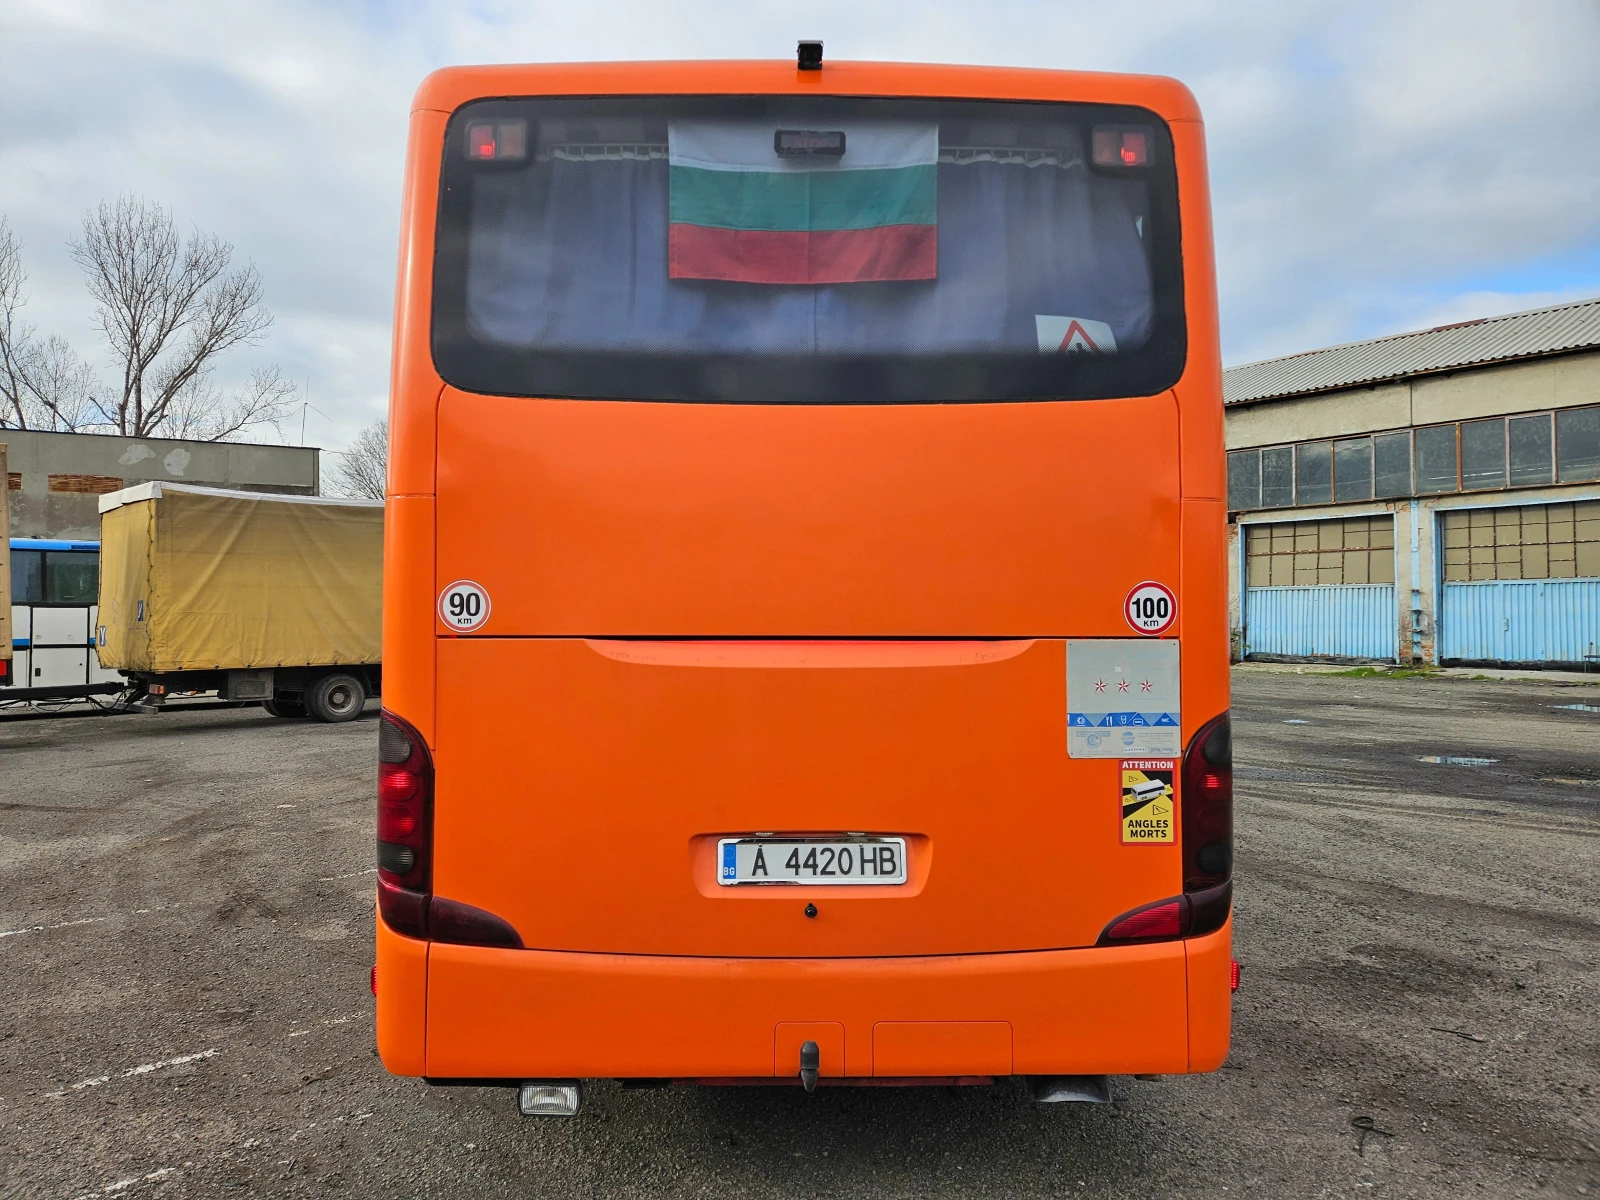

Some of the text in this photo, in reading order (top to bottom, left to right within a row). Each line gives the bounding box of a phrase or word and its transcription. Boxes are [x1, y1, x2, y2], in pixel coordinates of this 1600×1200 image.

[449, 592, 480, 617] 90
[1131, 597, 1169, 619] 100
[457, 617, 472, 625] km
[1122, 761, 1174, 769] ATTENTION
[1128, 820, 1169, 829] ANGLES
[1130, 830, 1167, 838] MORTS
[751, 847, 769, 877] A
[723, 866, 735, 876] BG
